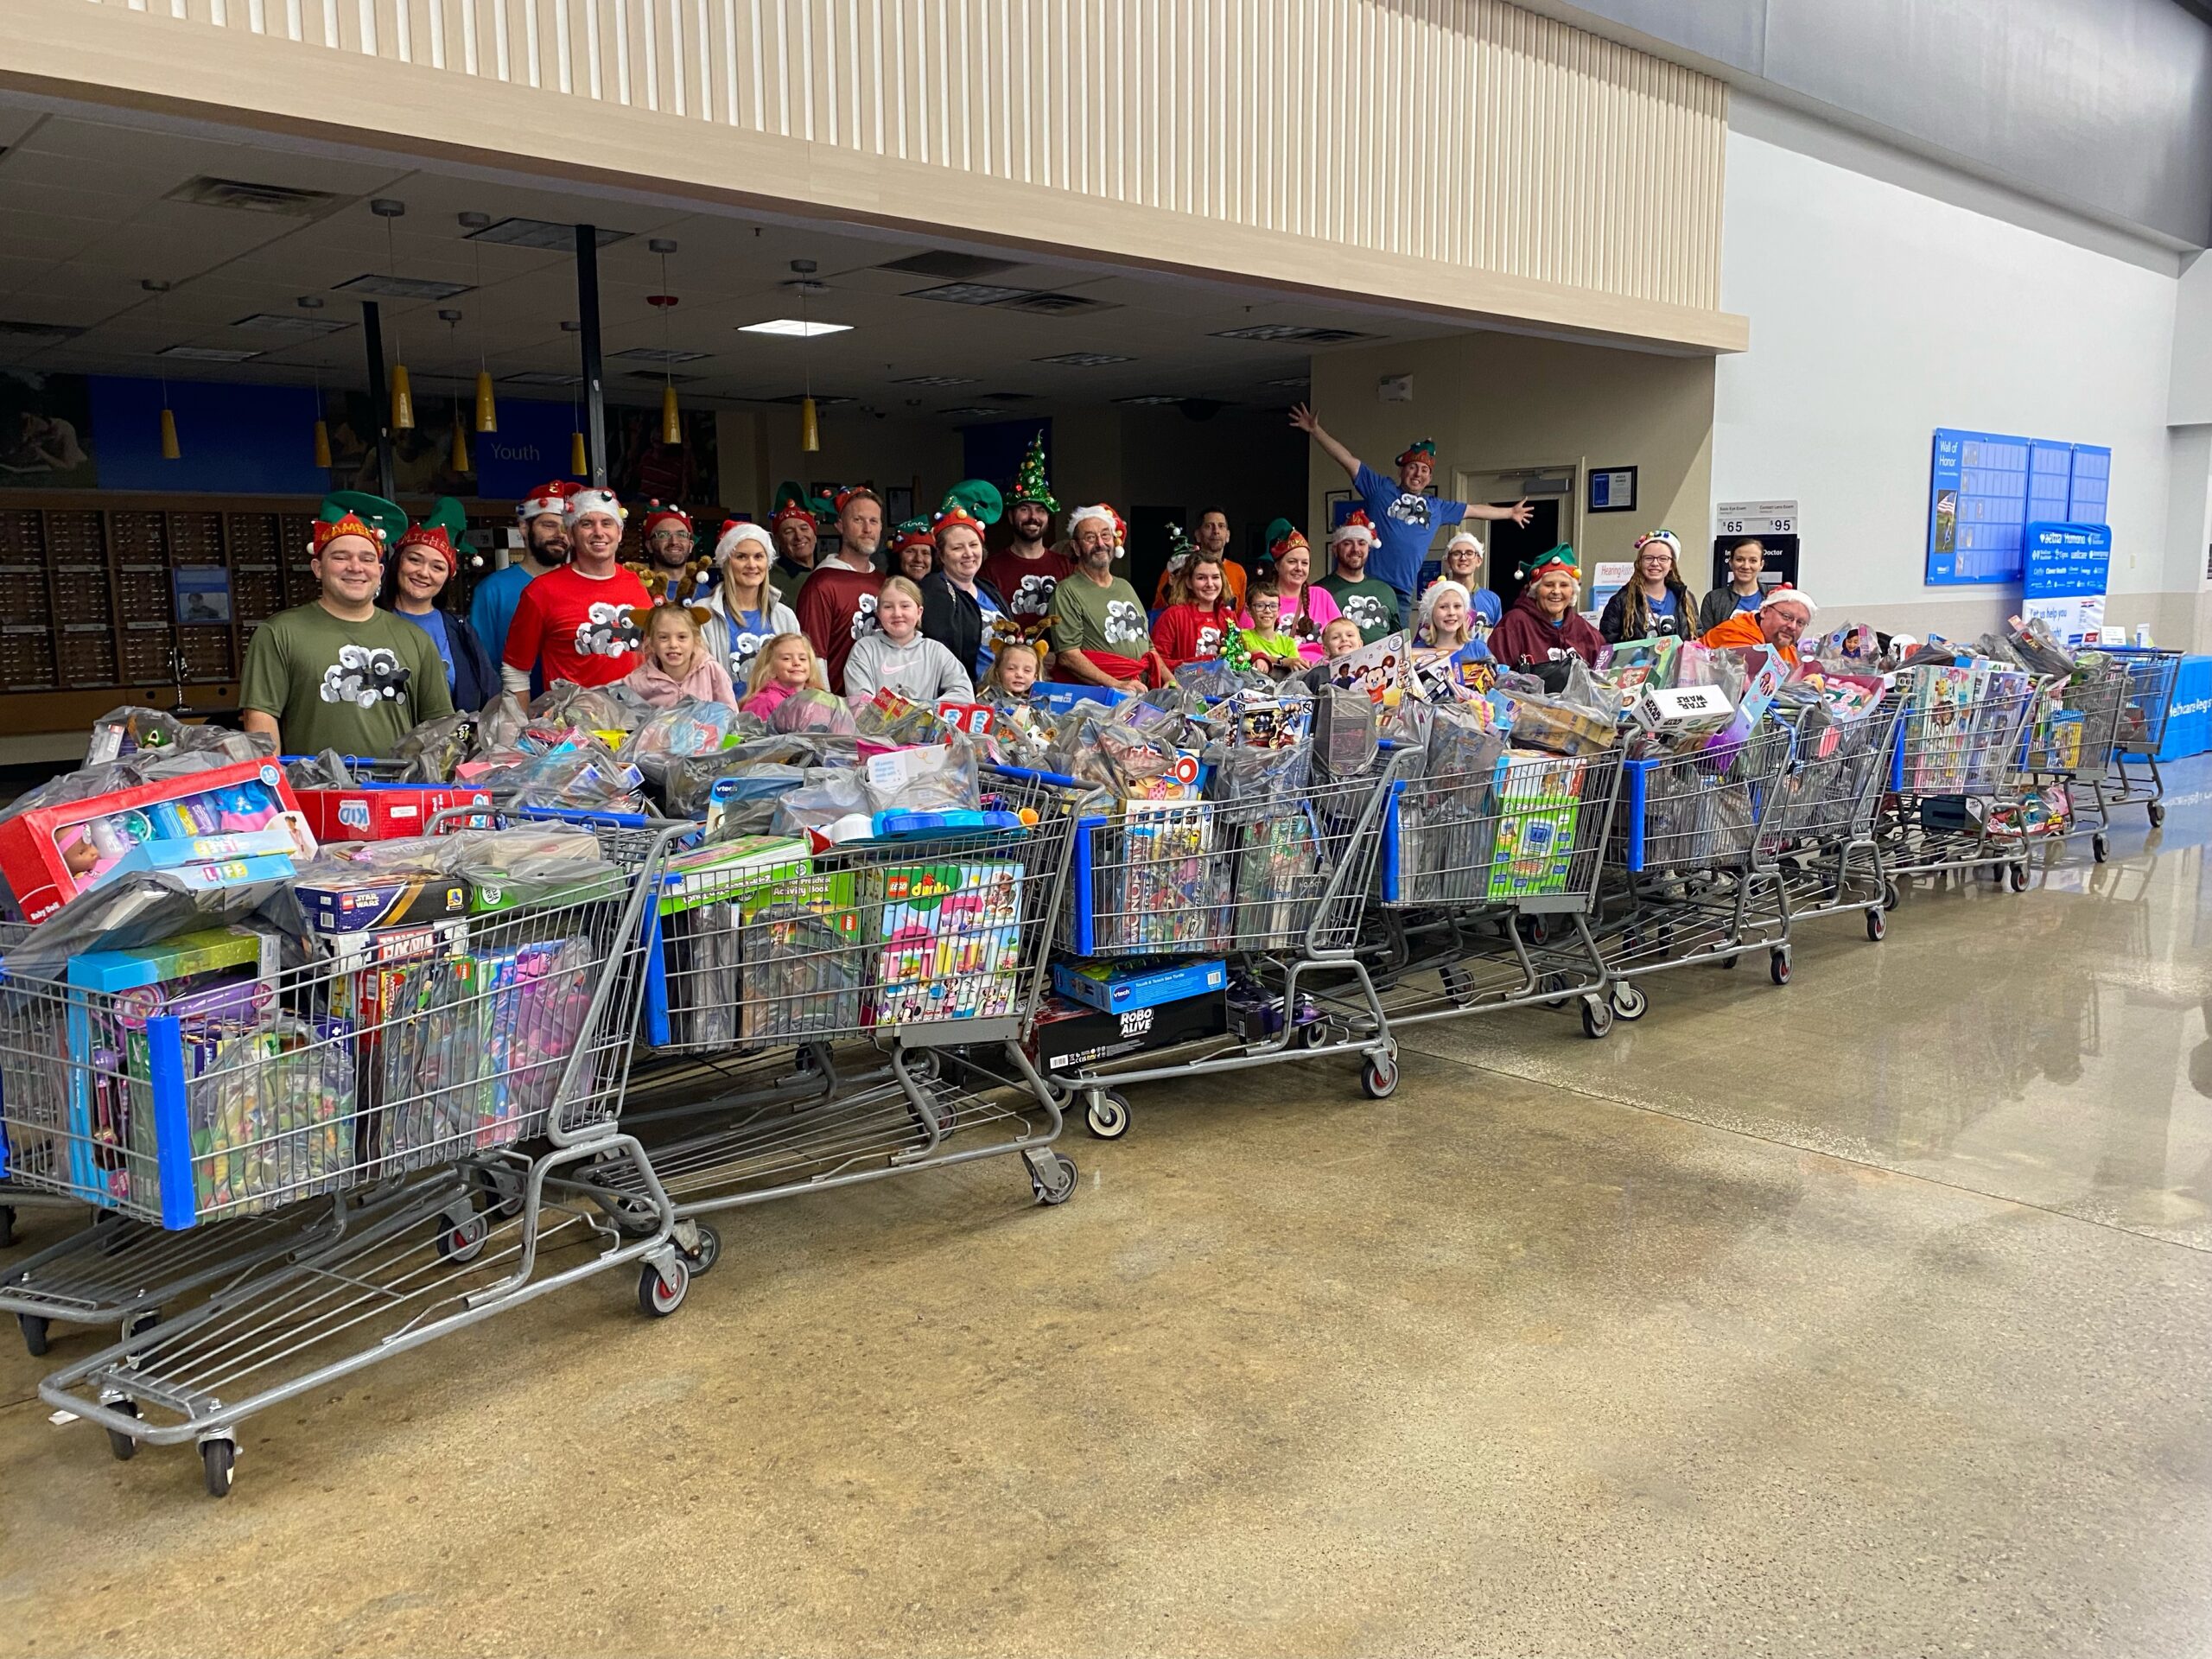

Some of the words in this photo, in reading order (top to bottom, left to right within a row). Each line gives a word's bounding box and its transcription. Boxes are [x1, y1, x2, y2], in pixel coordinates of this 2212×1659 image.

[491, 442, 540, 461] Youth
[1940, 441, 1951, 453] Wall
[1952, 442, 1958, 453] of
[1939, 454, 1956, 467] Honor
[1723, 521, 1742, 532] $65
[1770, 519, 1790, 531] $95
[2046, 608, 2057, 620] help
[2058, 609, 2068, 620] you
[1676, 695, 1707, 703] WARS
[1678, 701, 1708, 709] STAR
[974, 711, 987, 733] KID
[340, 807, 369, 825] KID
[203, 862, 248, 882] LIFE
[800, 876, 831, 886] Preschool
[890, 881, 907, 892] LEGO
[773, 884, 806, 898] Activity
[810, 885, 830, 893] Book
[1130, 836, 1141, 943] MONOPOLY
[355, 893, 378, 902] STAR
[356, 899, 380, 908] WARS
[30, 908, 46, 920] Baby
[45, 901, 60, 913] Doll
[1113, 988, 1130, 998] vtech
[1121, 1008, 1153, 1026] ROBO
[1121, 1020, 1152, 1036] ALIVE
